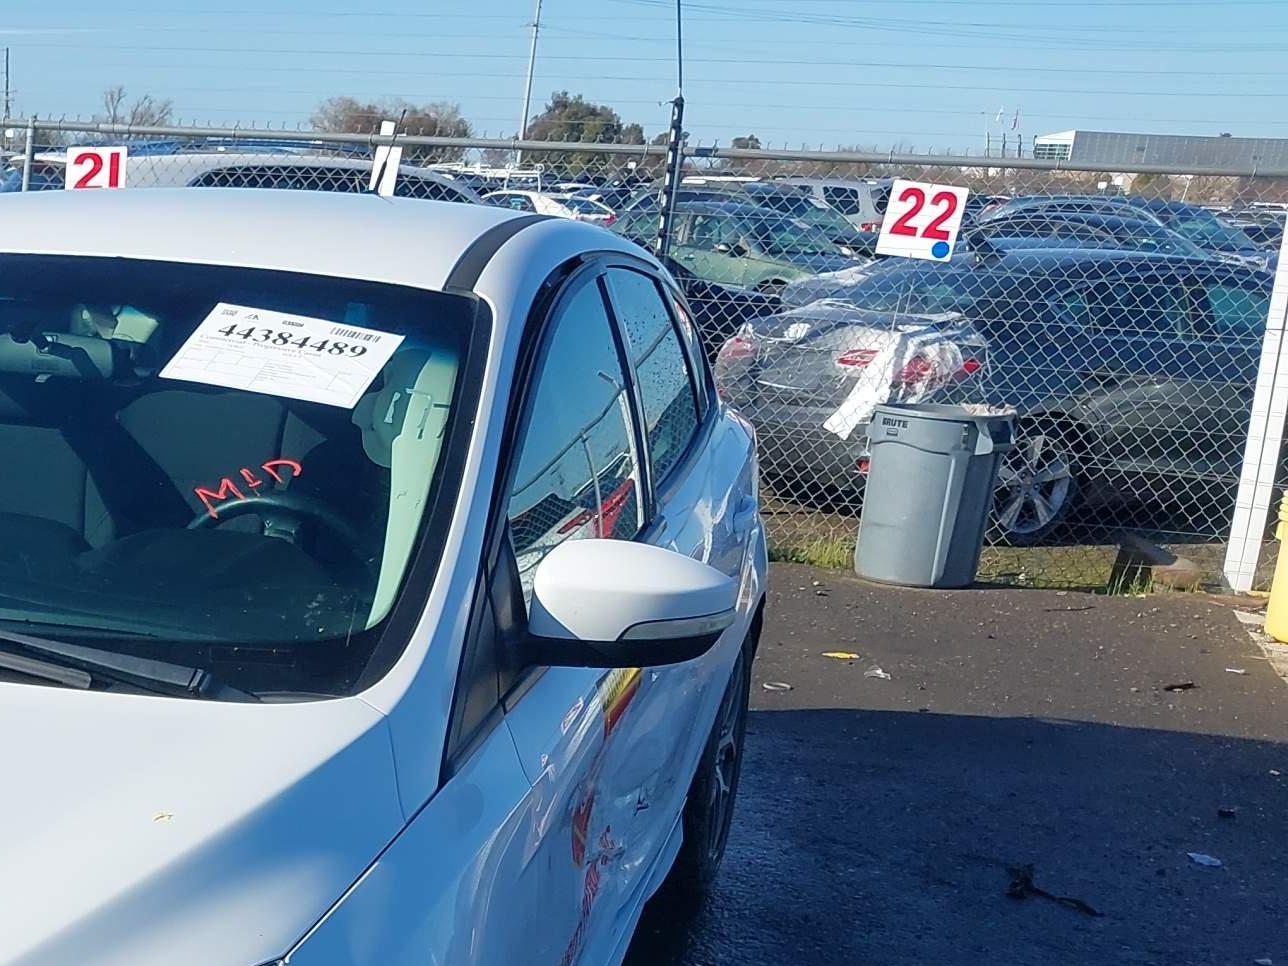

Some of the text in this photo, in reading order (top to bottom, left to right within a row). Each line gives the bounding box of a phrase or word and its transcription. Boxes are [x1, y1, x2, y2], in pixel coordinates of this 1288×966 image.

[73, 152, 121, 189] 21
[888, 187, 958, 240] 22
[217, 322, 368, 359] 44384489
[882, 417, 909, 428] BRUTE
